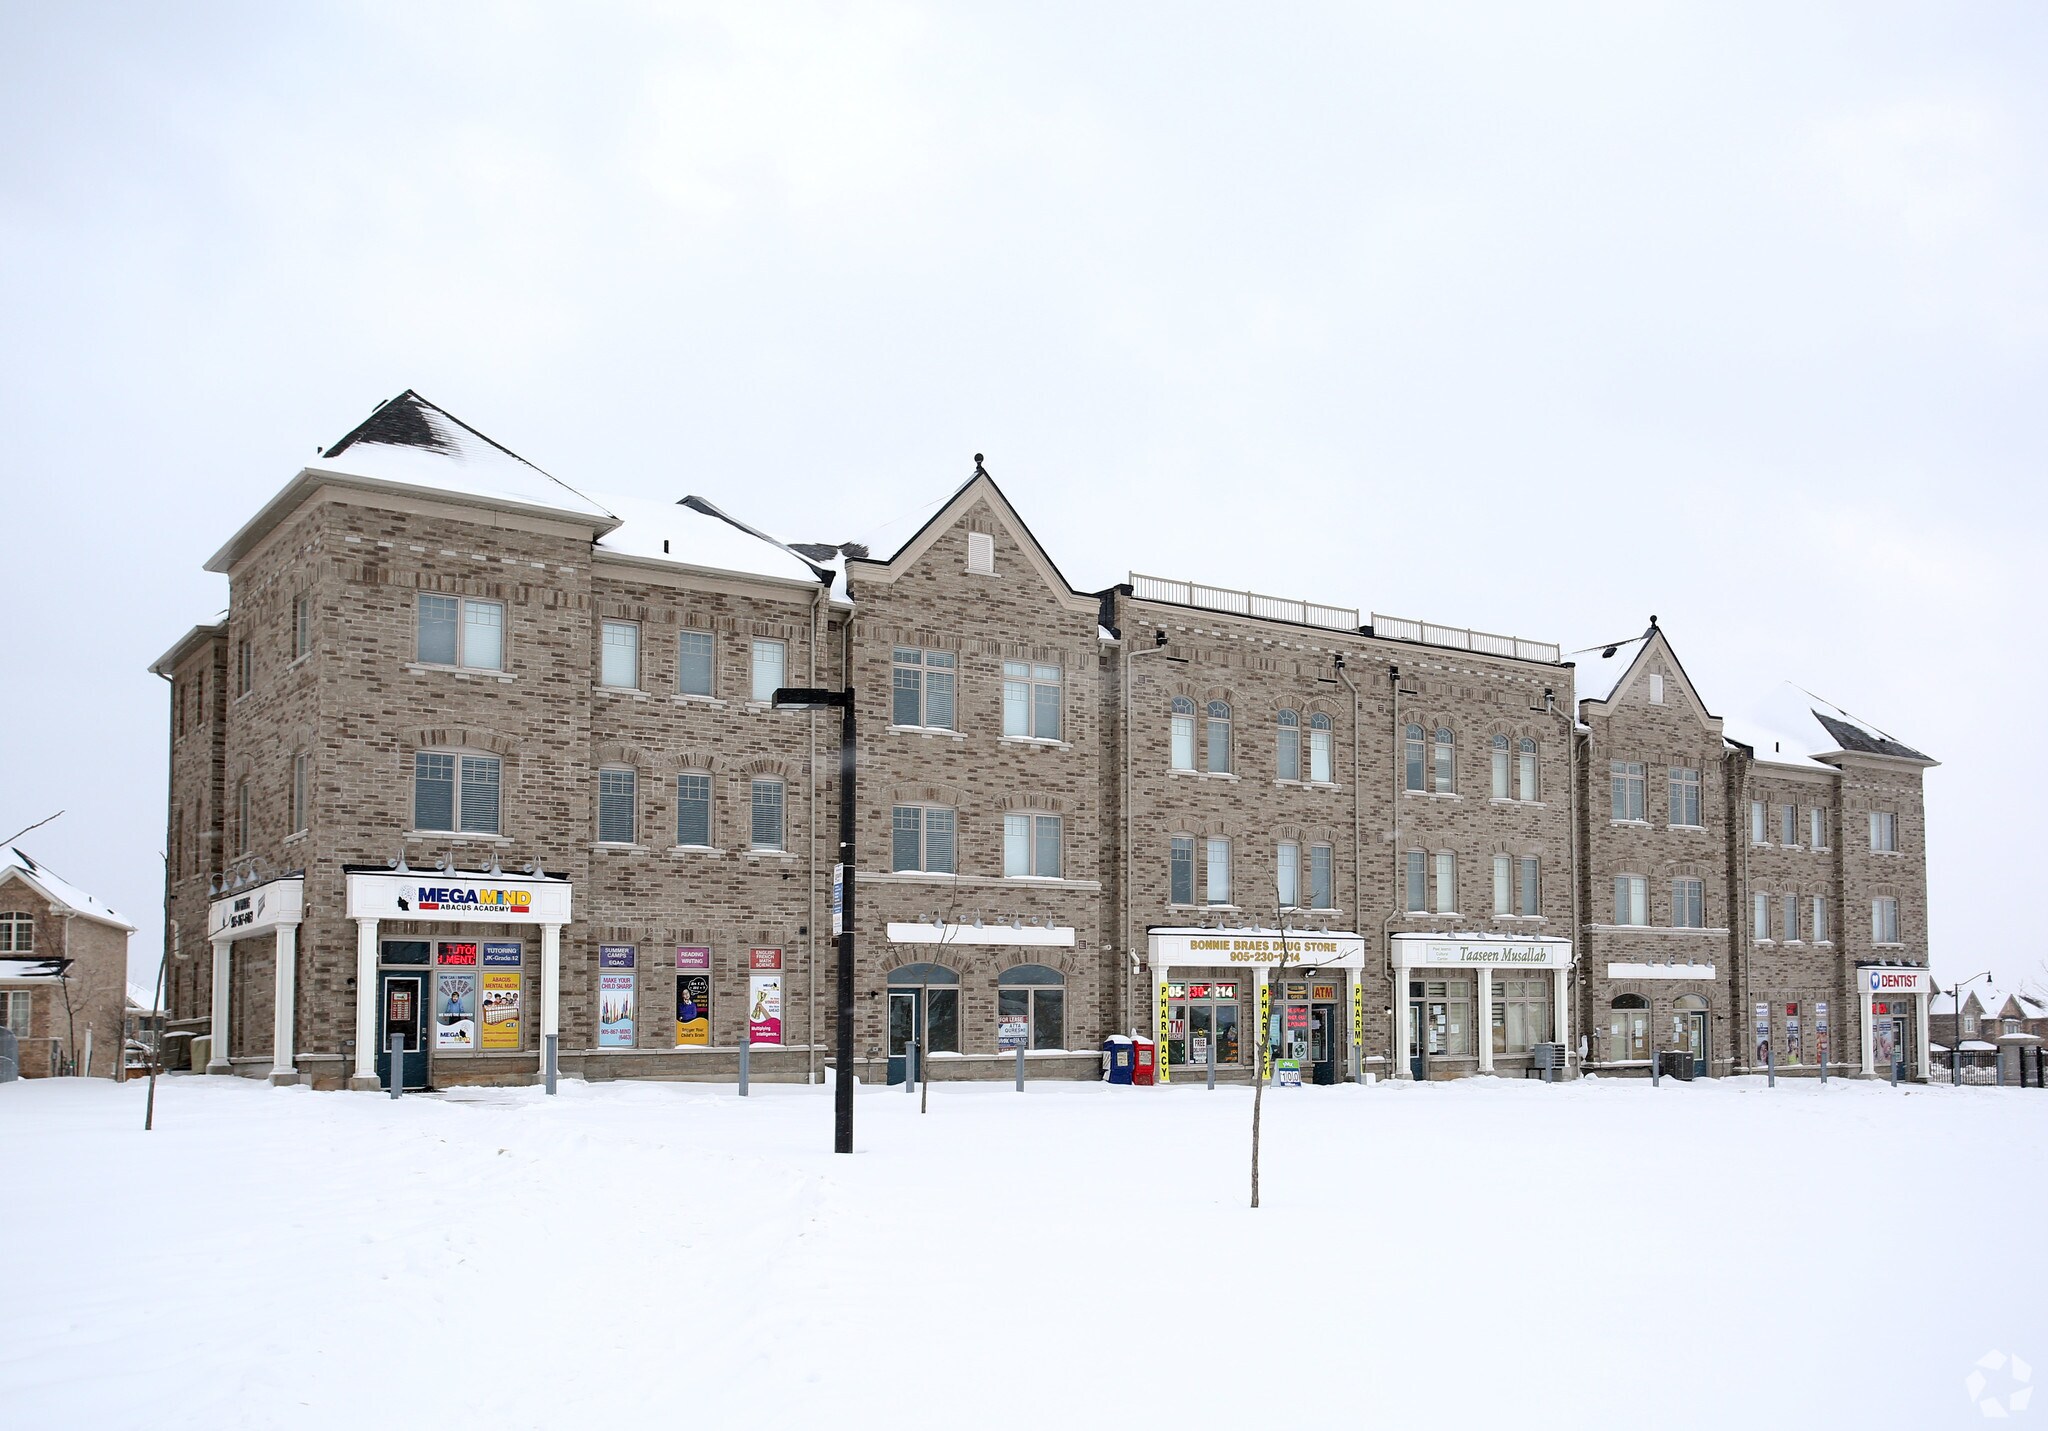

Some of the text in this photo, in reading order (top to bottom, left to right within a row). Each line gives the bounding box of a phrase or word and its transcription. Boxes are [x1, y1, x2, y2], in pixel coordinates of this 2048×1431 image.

[440, 903, 472, 911] ABACUS
[1190, 940, 1337, 952] BONNIE BRAES DRUG STORE
[1459, 947, 1546, 962] Taaseen Musallah
[1881, 975, 1917, 987] DENTIST
[1315, 987, 1333, 998] ATM
[1168, 1020, 1183, 1033] TM
[1195, 1039, 1205, 1047] FREE
[1282, 1072, 1298, 1081] 100
